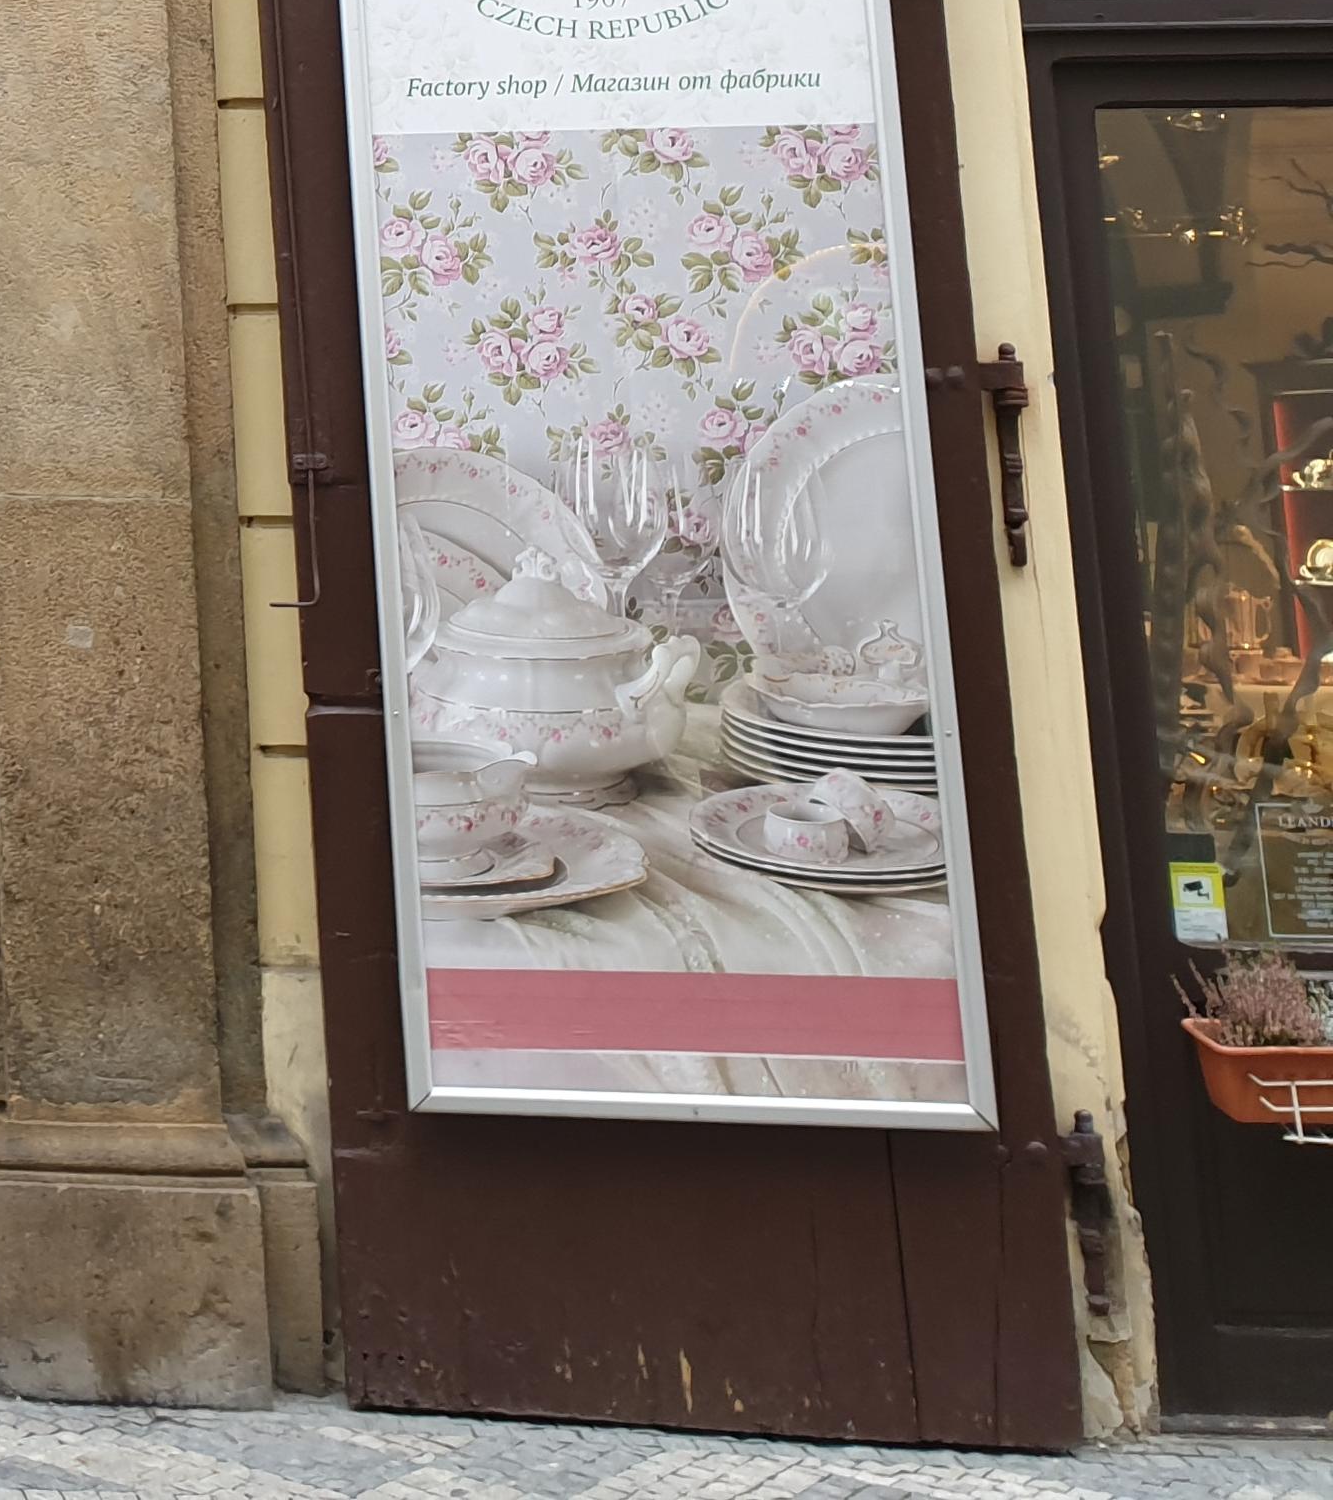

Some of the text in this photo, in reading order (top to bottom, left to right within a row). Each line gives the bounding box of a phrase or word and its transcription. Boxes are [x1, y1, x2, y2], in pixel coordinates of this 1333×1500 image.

[406, 78, 490, 100] Factory
[496, 75, 547, 98] shop
[571, 73, 670, 93] Магазин
[678, 74, 712, 91] от
[720, 69, 821, 94] фабрики
